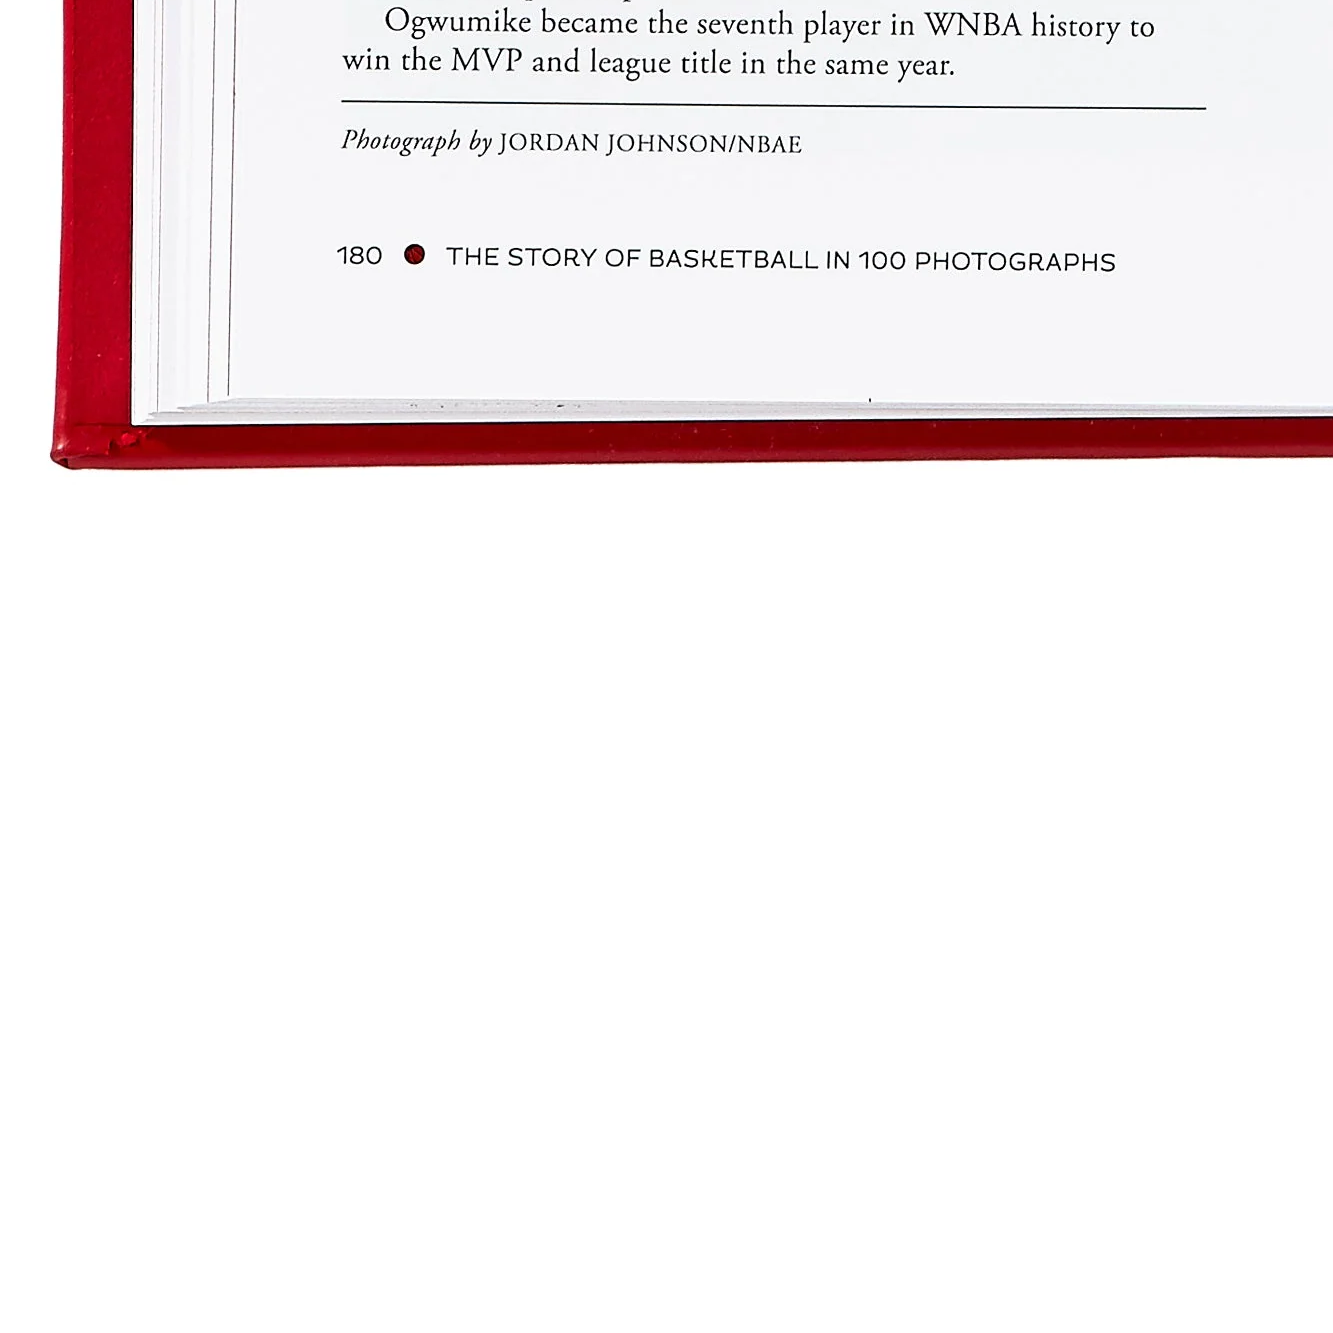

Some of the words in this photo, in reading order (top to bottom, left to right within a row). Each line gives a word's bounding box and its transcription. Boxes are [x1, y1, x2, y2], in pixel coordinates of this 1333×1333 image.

[342, 47, 390, 71] win
[401, 45, 442, 71] the
[451, 47, 523, 72] MVP
[532, 47, 580, 73] and
[590, 47, 671, 82] league
[681, 48, 732, 74] title
[741, 51, 766, 74] in
[776, 48, 816, 75] the
[824, 59, 889, 75] same
[897, 59, 955, 84] year.
[341, 127, 461, 157] Photograph
[469, 128, 493, 158] by
[497, 132, 599, 156] JORDAN
[605, 133, 802, 157] JOHNSON/NBAE
[336, 245, 383, 265] 180
[445, 246, 500, 266] THE
[508, 247, 598, 267] STORY
[605, 248, 642, 268] OF
[649, 249, 819, 270] BASKETBALL
[826, 250, 850, 270] IN
[858, 250, 906, 270] 100
[915, 251, 1116, 273] PHOTOGRAPHS
